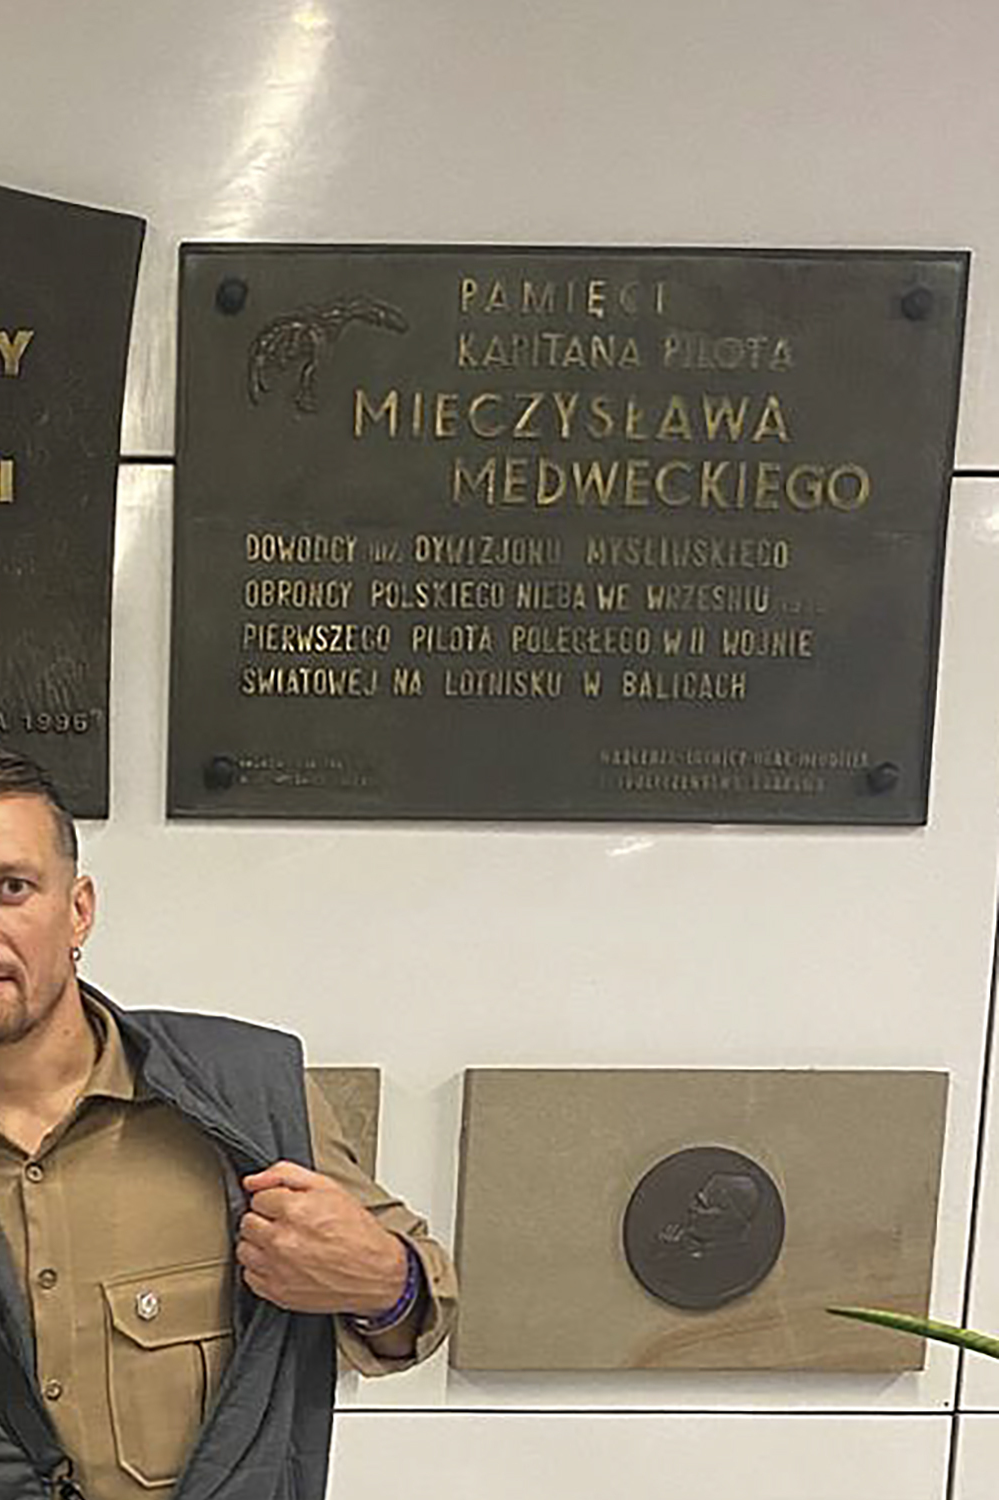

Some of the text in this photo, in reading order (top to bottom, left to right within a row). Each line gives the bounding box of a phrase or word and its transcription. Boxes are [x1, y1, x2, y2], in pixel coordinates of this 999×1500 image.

[461, 277, 665, 317] PAMIĘCI
[458, 331, 796, 371] KAPITANA PILOTA
[353, 389, 792, 442] MIECZYSŁAWA
[453, 457, 871, 512] MEDWECKIEGO
[371, 580, 504, 609] POLSKIEGO
[517, 582, 587, 612] NIEBA
[598, 583, 631, 611] WE
[243, 623, 391, 651] PIERWSZEGO
[412, 624, 493, 652] PILOTA
[511, 625, 650, 654] POLEGŁEGO
[663, 629, 683, 655] W
[723, 629, 814, 658] WOJNIE
[393, 667, 423, 696] NA
[445, 669, 562, 698] LOTNISKU
[584, 671, 602, 697] W
[622, 671, 747, 699] BALICACH
